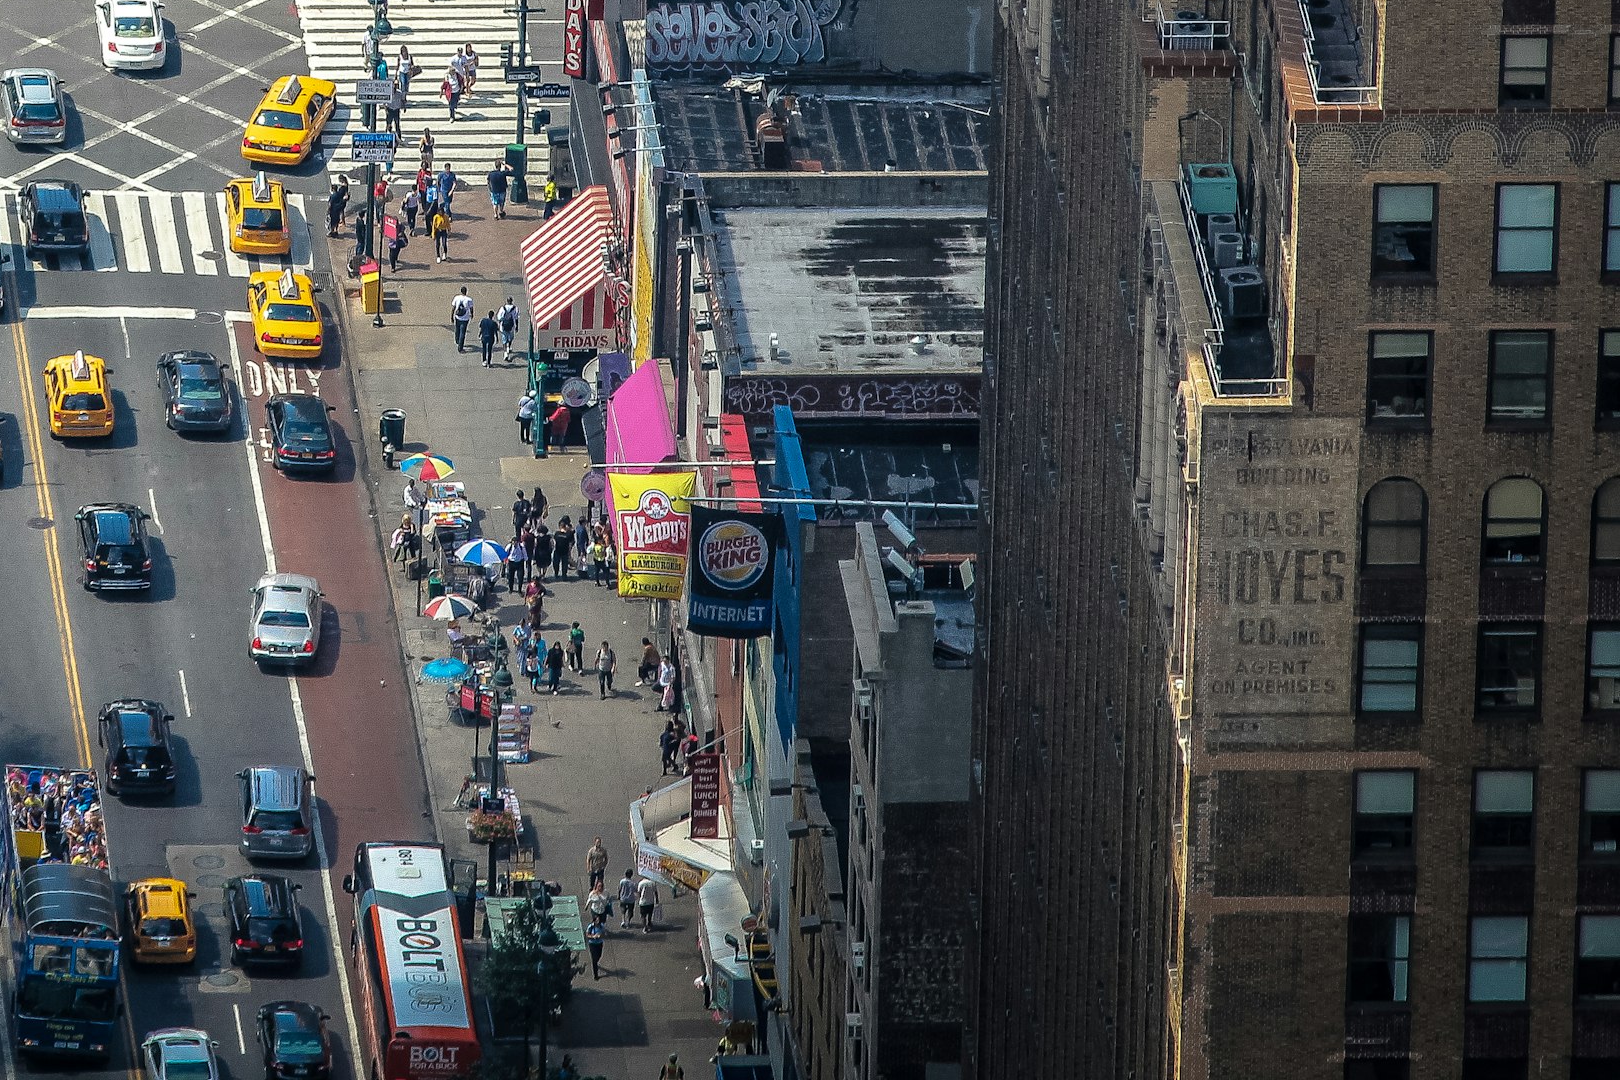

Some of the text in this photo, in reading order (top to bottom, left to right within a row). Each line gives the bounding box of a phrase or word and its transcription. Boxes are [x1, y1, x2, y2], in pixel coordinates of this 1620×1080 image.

[533, 89, 554, 98] Eighth
[246, 361, 323, 398] ONLY
[1236, 468, 1330, 485] BUILDING
[707, 535, 759, 554] BURGER
[631, 559, 682, 571] HAMBURGERS
[707, 547, 762, 572] KING
[1209, 549, 1346, 606] NOYES
[631, 580, 679, 594] Breakfast
[692, 601, 766, 622] INTERNET
[1235, 661, 1311, 675] AGENT
[1211, 680, 1336, 694] ON PREMISES
[694, 791, 718, 800] LUNCH
[701, 800, 709, 809] &
[693, 808, 717, 818] DINNER
[410, 1046, 459, 1063] BOLT
[435, 1062, 458, 1070] BUCK
